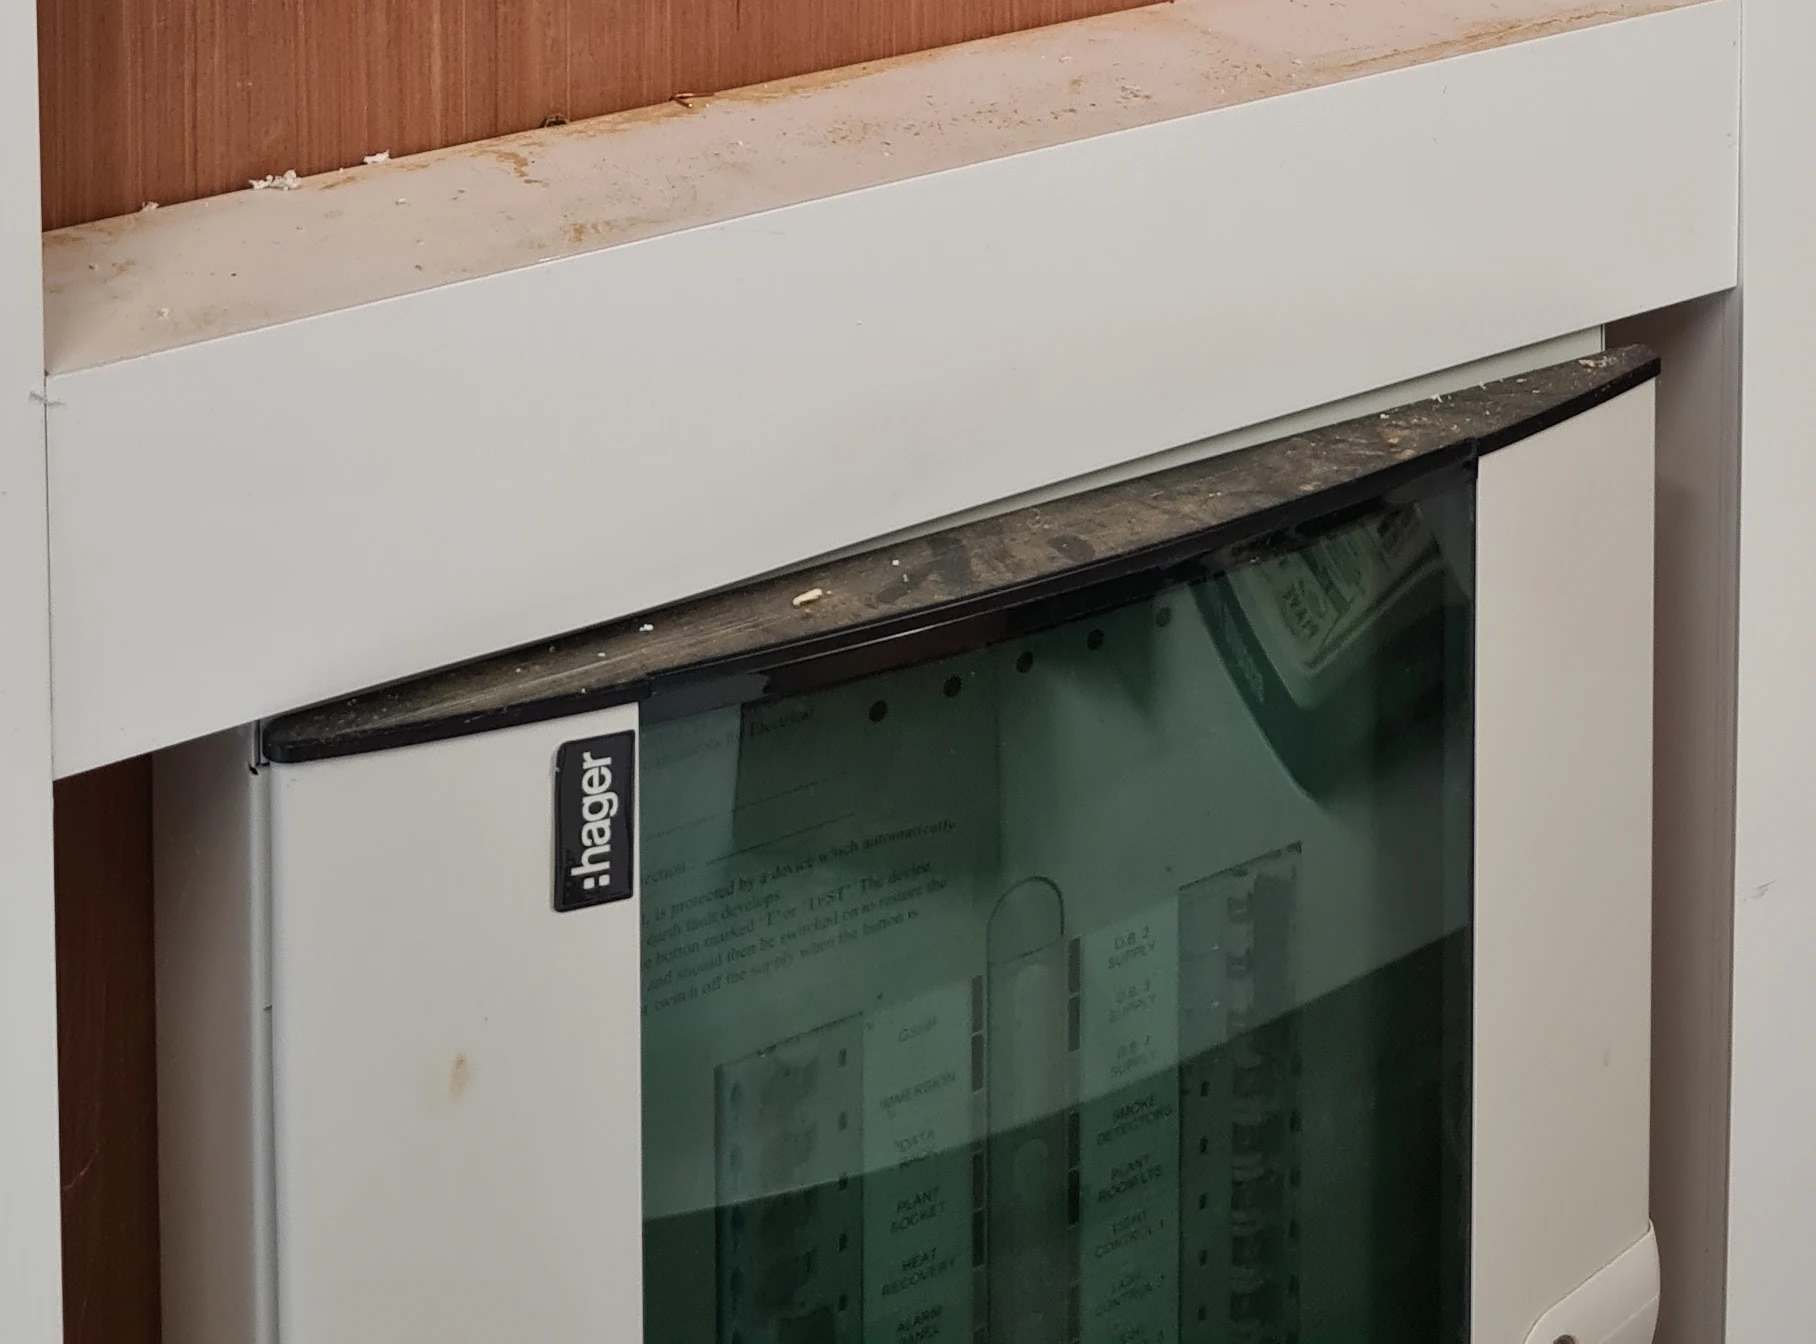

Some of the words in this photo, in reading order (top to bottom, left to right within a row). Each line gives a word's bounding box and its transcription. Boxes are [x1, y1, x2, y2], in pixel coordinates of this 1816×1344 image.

[671, 879, 735, 920] protected
[738, 877, 754, 893] by
[771, 858, 815, 880] device
[818, 839, 859, 864] which
[862, 818, 957, 851] automatically
[703, 919, 755, 948] marked
[896, 1184, 941, 1213] PLANT
[890, 1199, 946, 1234] SOCKET
[902, 1246, 938, 1272] HEAT
